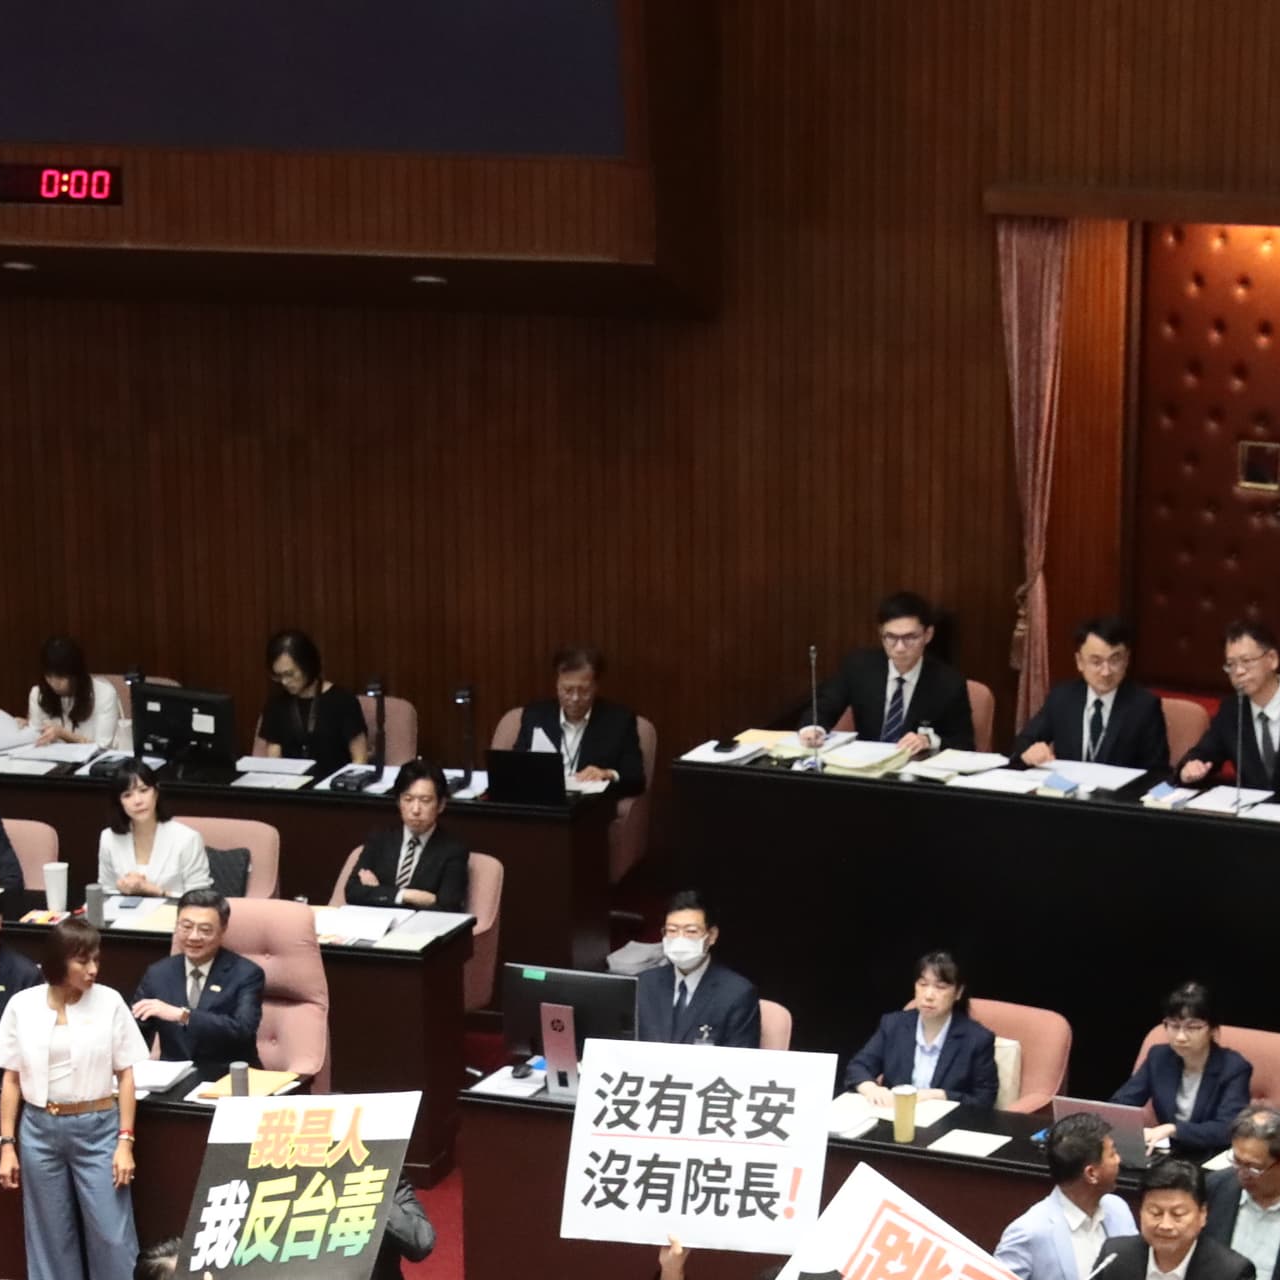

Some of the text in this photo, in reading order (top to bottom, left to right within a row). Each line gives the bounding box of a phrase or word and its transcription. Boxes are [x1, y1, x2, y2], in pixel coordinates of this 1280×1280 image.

[40, 168, 111, 199] 0:00
[247, 1105, 370, 1169] 我是人
[592, 1071, 796, 1141] 沒有食安
[189, 1165, 390, 1271] 我反台毒
[581, 1149, 803, 1221] 沒有院長!
